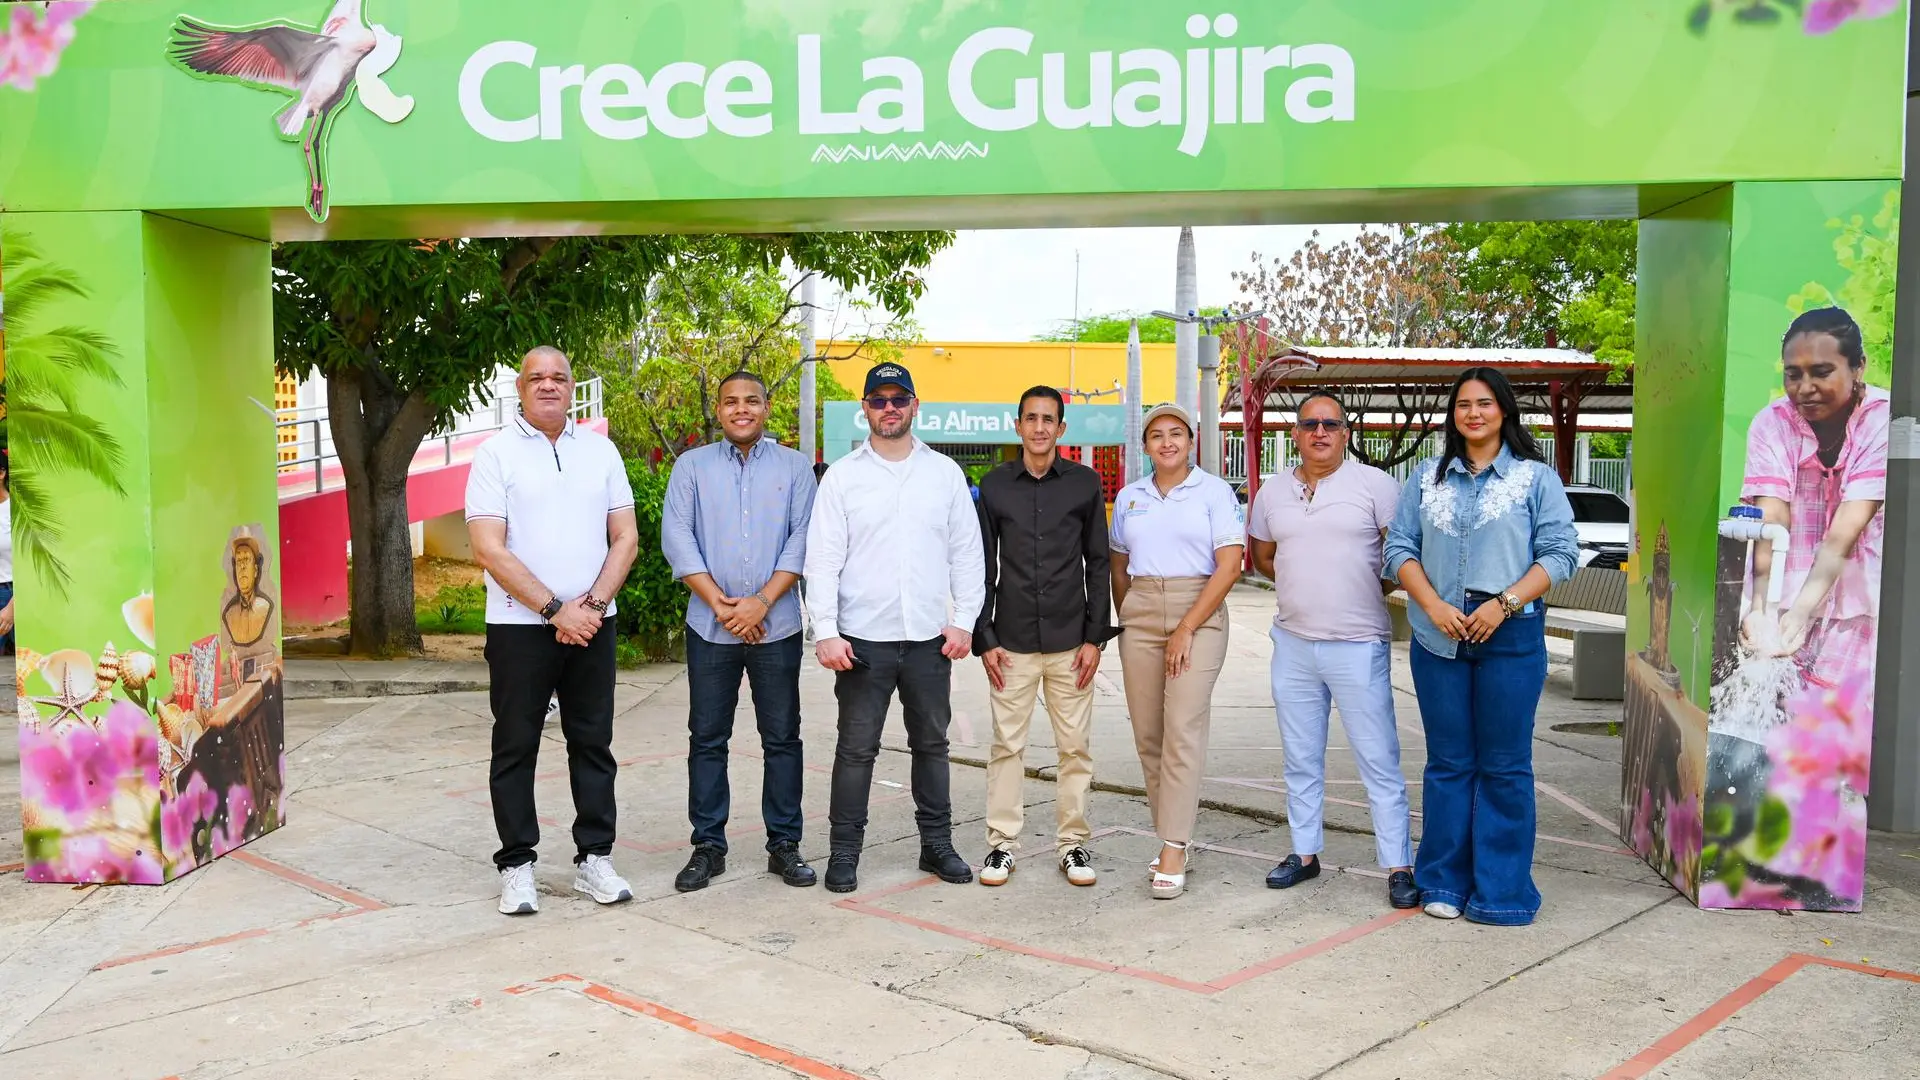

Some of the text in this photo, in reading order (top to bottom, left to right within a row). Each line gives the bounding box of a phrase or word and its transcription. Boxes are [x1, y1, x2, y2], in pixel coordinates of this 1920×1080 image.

[458, 13, 1357, 158] Crece La Guajira
[917, 410, 941, 431] La
[943, 409, 1000, 432] Alma
